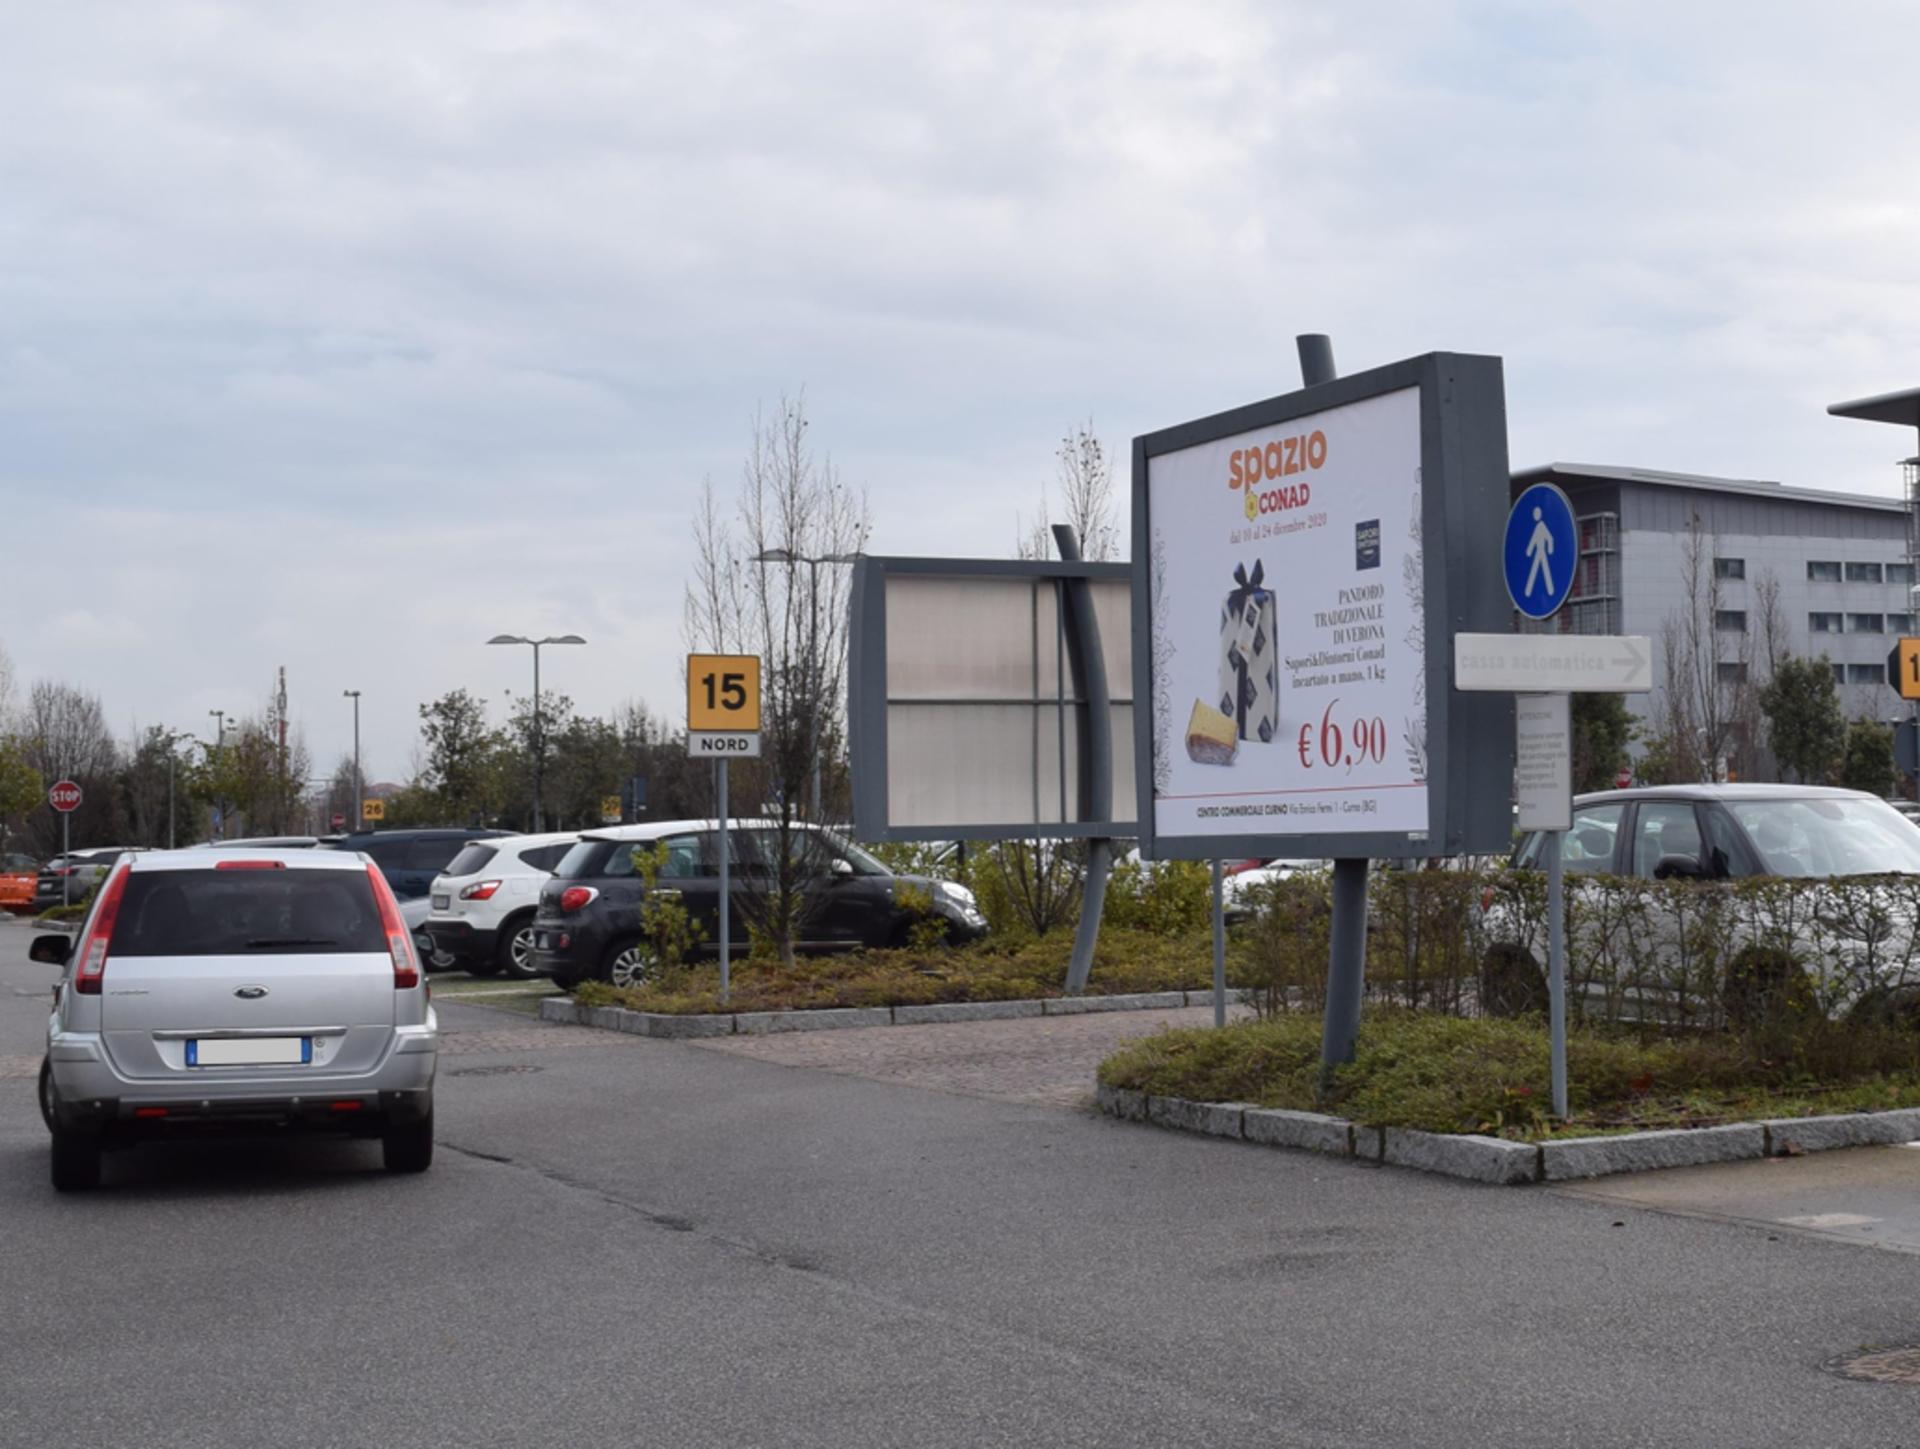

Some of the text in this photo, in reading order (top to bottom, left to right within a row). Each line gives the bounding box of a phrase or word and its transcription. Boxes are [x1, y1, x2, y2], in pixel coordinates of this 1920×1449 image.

[1229, 430, 1327, 495] spazio
[1259, 483, 1310, 514] CONAD
[1273, 518, 1306, 536] dicembre
[1338, 584, 1384, 604] PANDORO
[1314, 604, 1384, 627] TRADIZIONALE
[1333, 625, 1385, 644] DI VERONA
[1356, 643, 1384, 662] Conad
[1461, 651, 1605, 671] cassa automatica
[1374, 664, 1386, 684] kg
[702, 673, 746, 711] 15
[702, 739, 748, 750] NORD
[1320, 698, 1386, 776] 6,90
[53, 790, 79, 801] STOP
